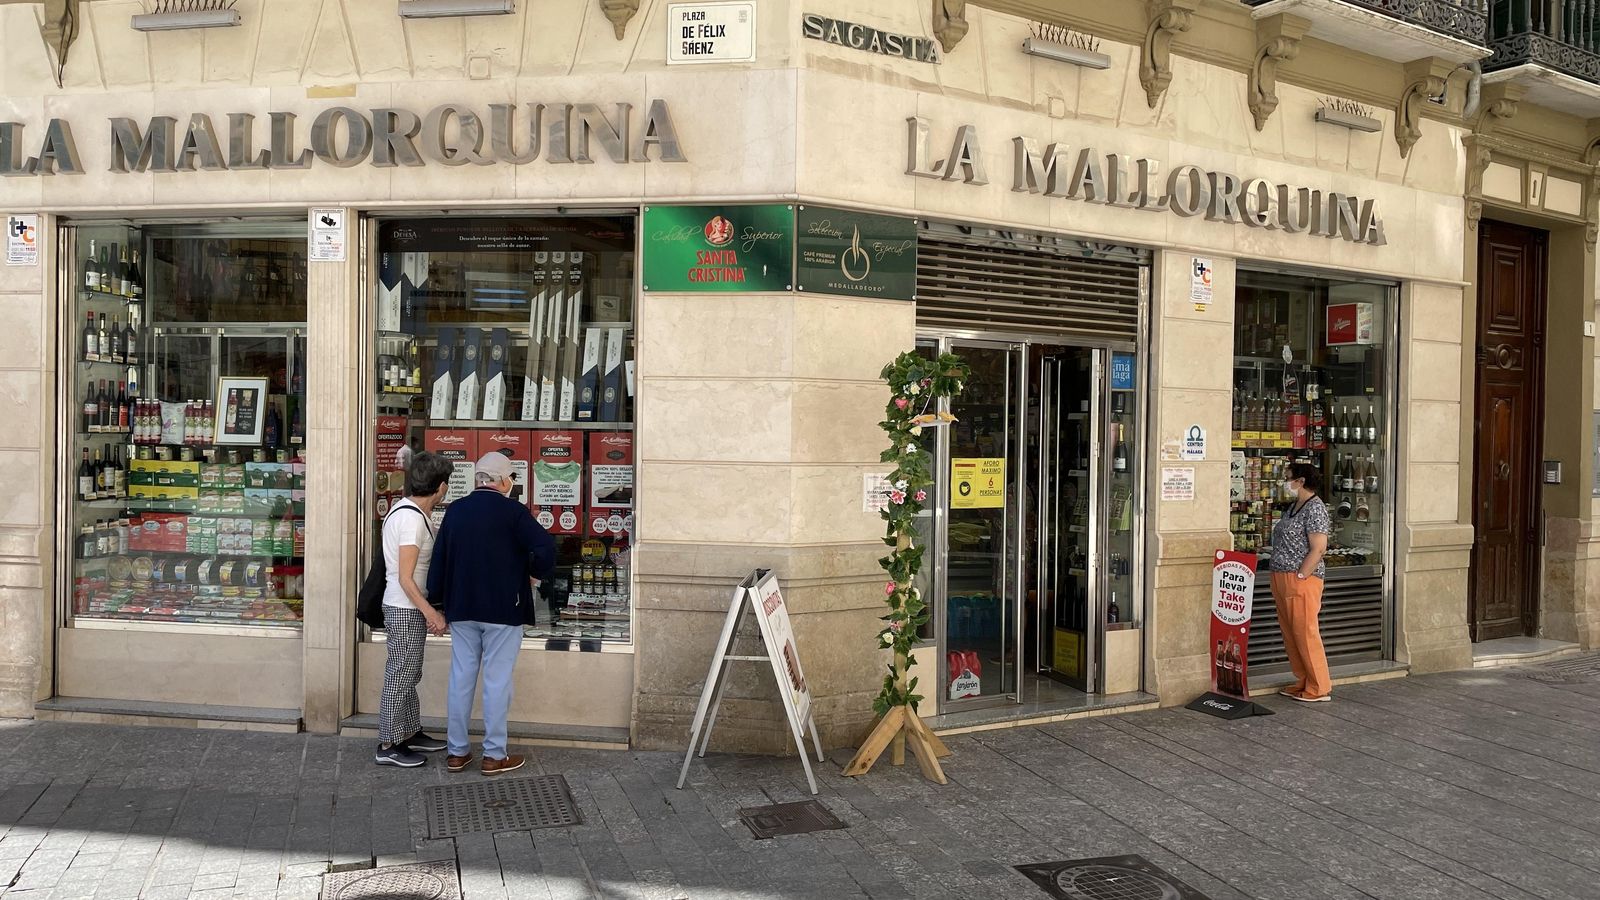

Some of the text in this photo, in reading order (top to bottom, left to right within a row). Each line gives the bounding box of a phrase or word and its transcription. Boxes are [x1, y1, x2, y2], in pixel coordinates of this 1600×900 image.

[682, 11, 706, 21] PLAZA
[682, 23, 726, 39] DE FÉLIX
[804, 13, 941, 64] SAGASTA
[682, 40, 714, 55] SÁENZ
[0, 98, 689, 177] LA MALLORQUINA
[904, 115, 1389, 246] LA MALLORQUINA
[1532, 179, 1538, 199] 1
[740, 226, 783, 253] Superior
[696, 250, 738, 265] SANTA
[687, 267, 746, 283] CRISTINA
[988, 477, 993, 486] 6
[1216, 563, 1238, 571] BEBIDAS
[1222, 571, 1245, 582] Para
[1220, 580, 1247, 592] llevar
[1220, 590, 1245, 603] Take
[1218, 600, 1245, 614] away
[1216, 610, 1227, 621] COLD
